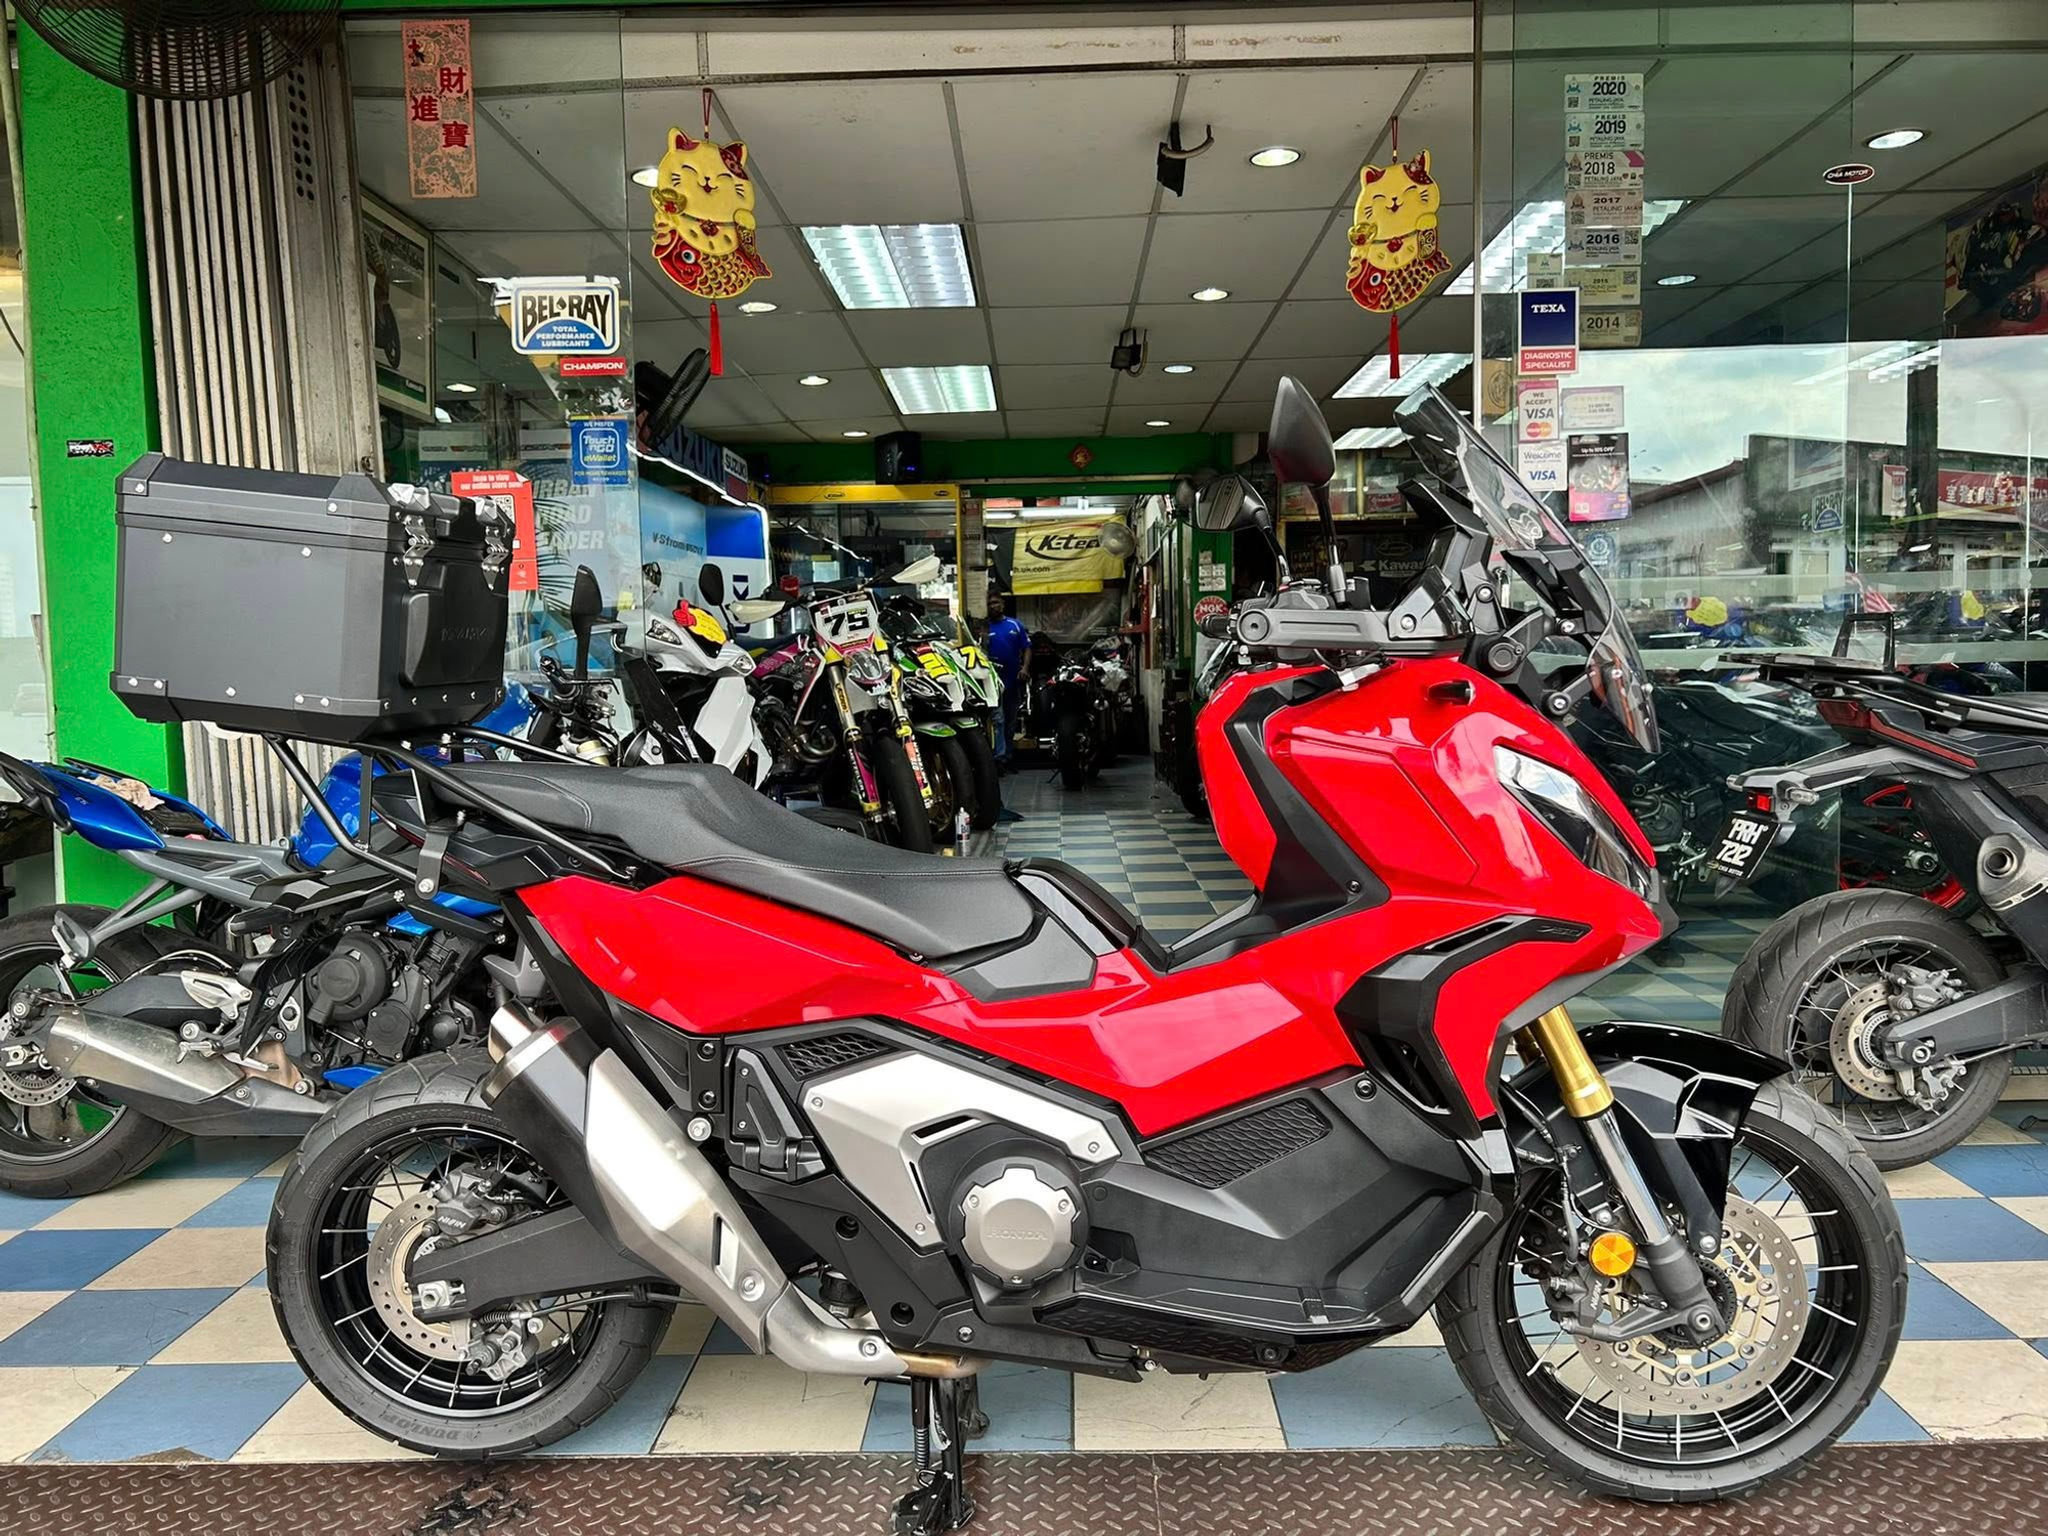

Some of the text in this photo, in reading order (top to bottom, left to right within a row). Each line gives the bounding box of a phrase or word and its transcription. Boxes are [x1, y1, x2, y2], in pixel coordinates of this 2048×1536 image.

[1593, 82, 1626, 95] 2020
[1595, 120, 1626, 134] 2019
[1584, 152, 1614, 160] PREMIS
[1584, 161, 1615, 175] 2018
[1586, 234, 1620, 244] 2016
[1531, 304, 1566, 313] TEXA
[1586, 316, 1620, 329] 2014
[1524, 351, 1572, 359] DIAGNOSTIC
[563, 362, 624, 371] CHAMPION
[1525, 361, 1571, 369] SPECIALIST
[1525, 408, 1554, 419] VISA
[583, 435, 615, 445] Touch
[1524, 452, 1562, 460] Welcome
[725, 455, 748, 479] SUZUKI
[1529, 470, 1557, 480] VISA
[1200, 603, 1224, 613] NGK
[824, 612, 870, 637] 75
[1716, 839, 1753, 867] 7212
[986, 1229, 1050, 1240] HONDA
